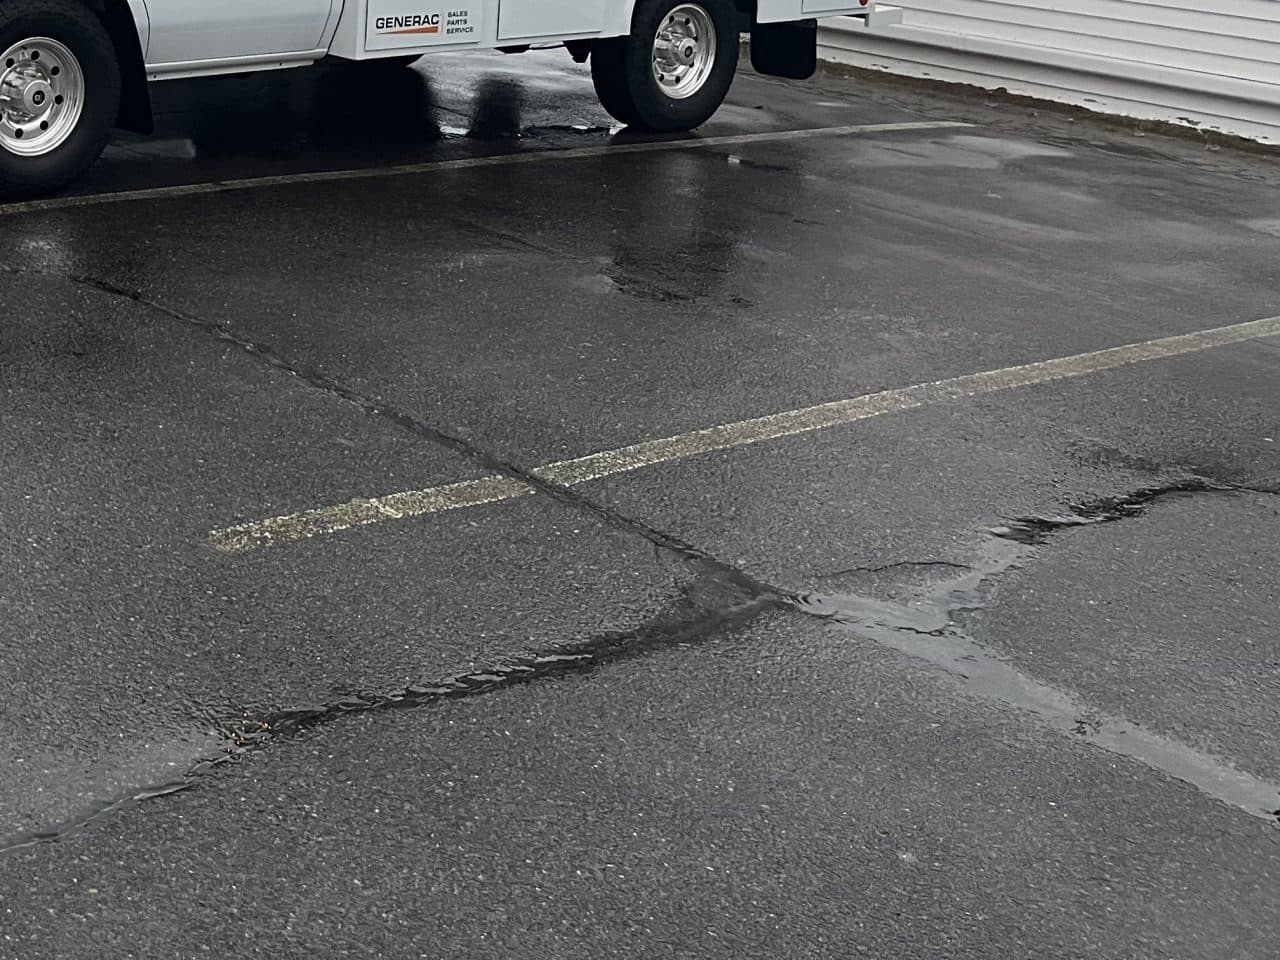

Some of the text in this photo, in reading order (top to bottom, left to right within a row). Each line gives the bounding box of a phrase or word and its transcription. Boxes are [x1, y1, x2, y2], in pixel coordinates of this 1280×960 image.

[447, 10, 468, 18] SALES
[375, 14, 439, 29] GENERAC
[447, 18, 468, 26] PARTS
[446, 26, 474, 34] SERVICE
